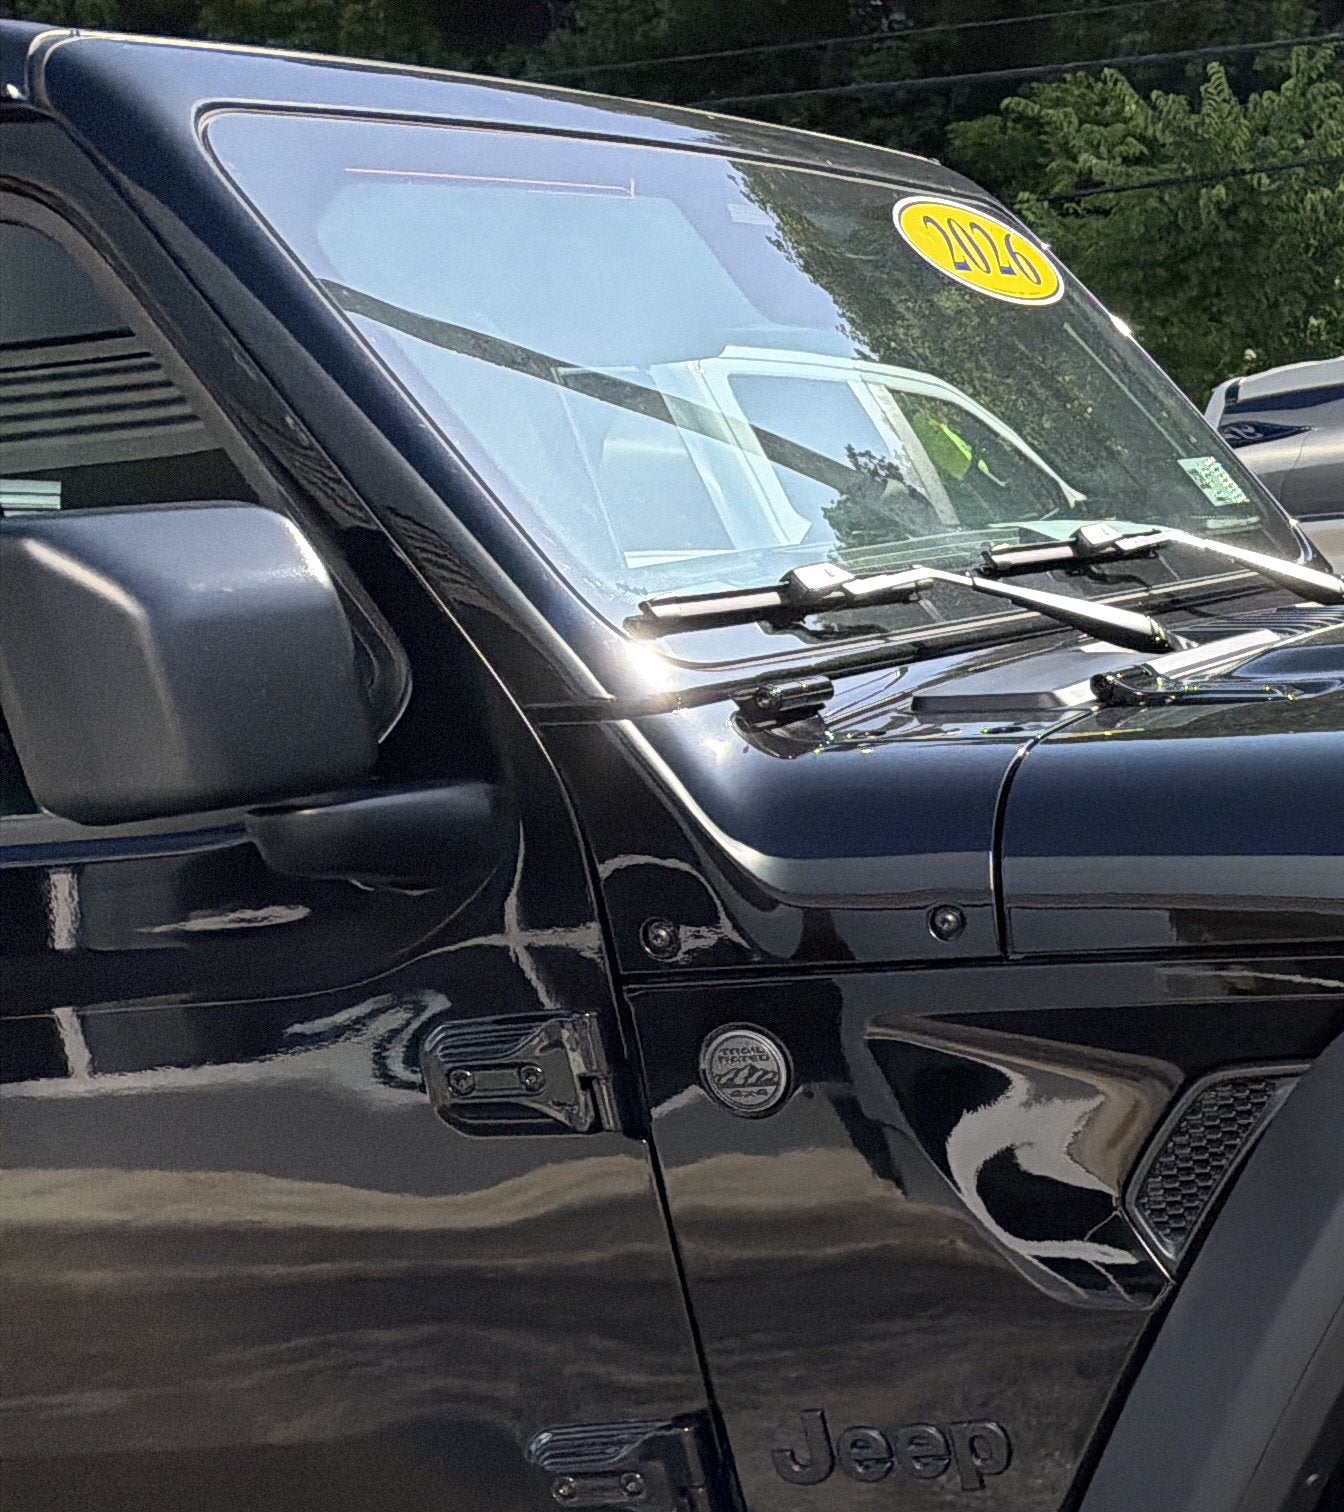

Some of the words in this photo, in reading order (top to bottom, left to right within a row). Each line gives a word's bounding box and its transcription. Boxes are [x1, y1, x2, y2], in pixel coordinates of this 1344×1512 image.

[923, 214, 1043, 287] 2026
[717, 1055, 770, 1065] RATED
[719, 1046, 766, 1056] TRAIL
[771, 1408, 1012, 1492] Jeep
